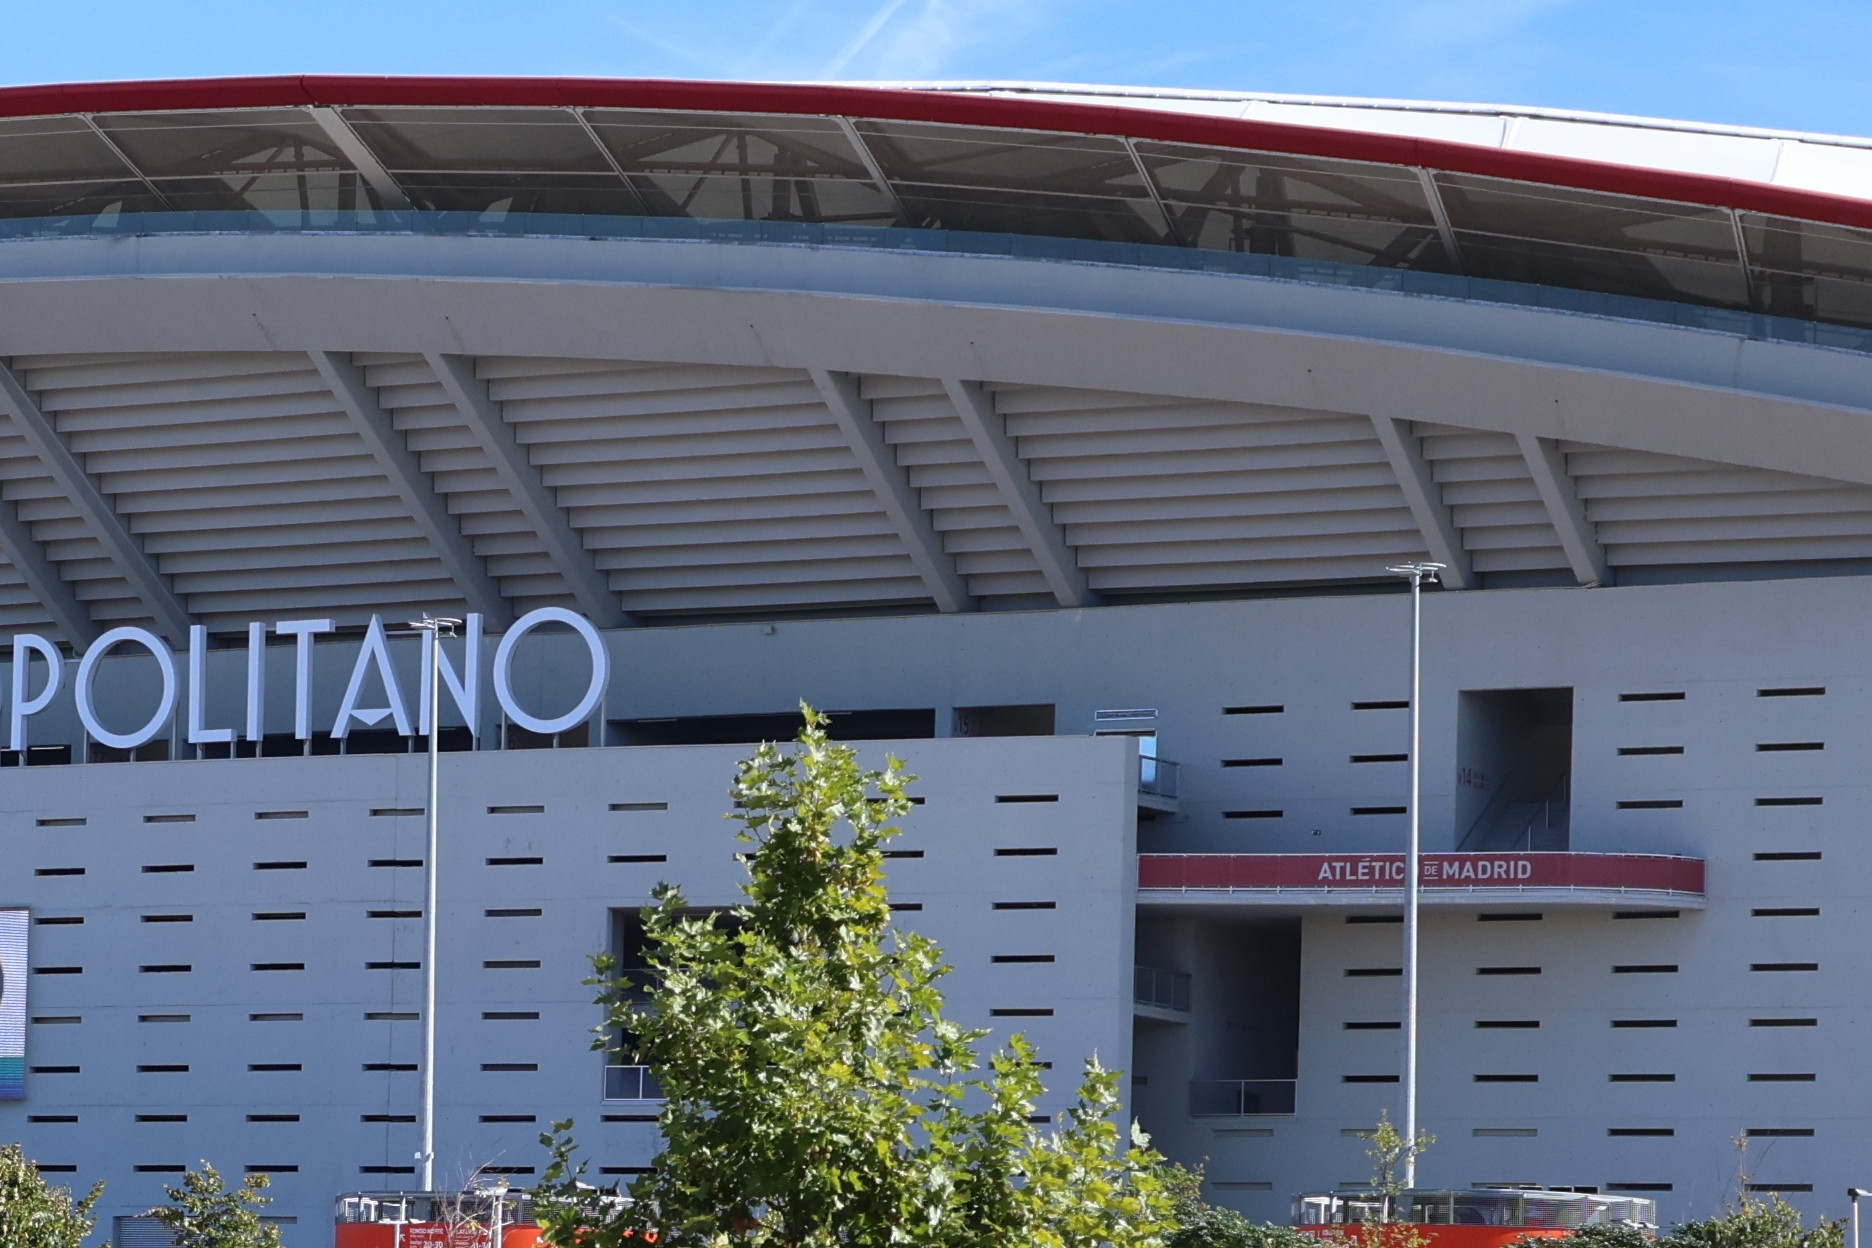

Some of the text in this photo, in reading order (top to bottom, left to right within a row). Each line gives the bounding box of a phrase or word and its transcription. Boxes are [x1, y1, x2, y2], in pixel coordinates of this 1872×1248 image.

[1318, 857, 1532, 881] ATLÉTIC DE MADRID
